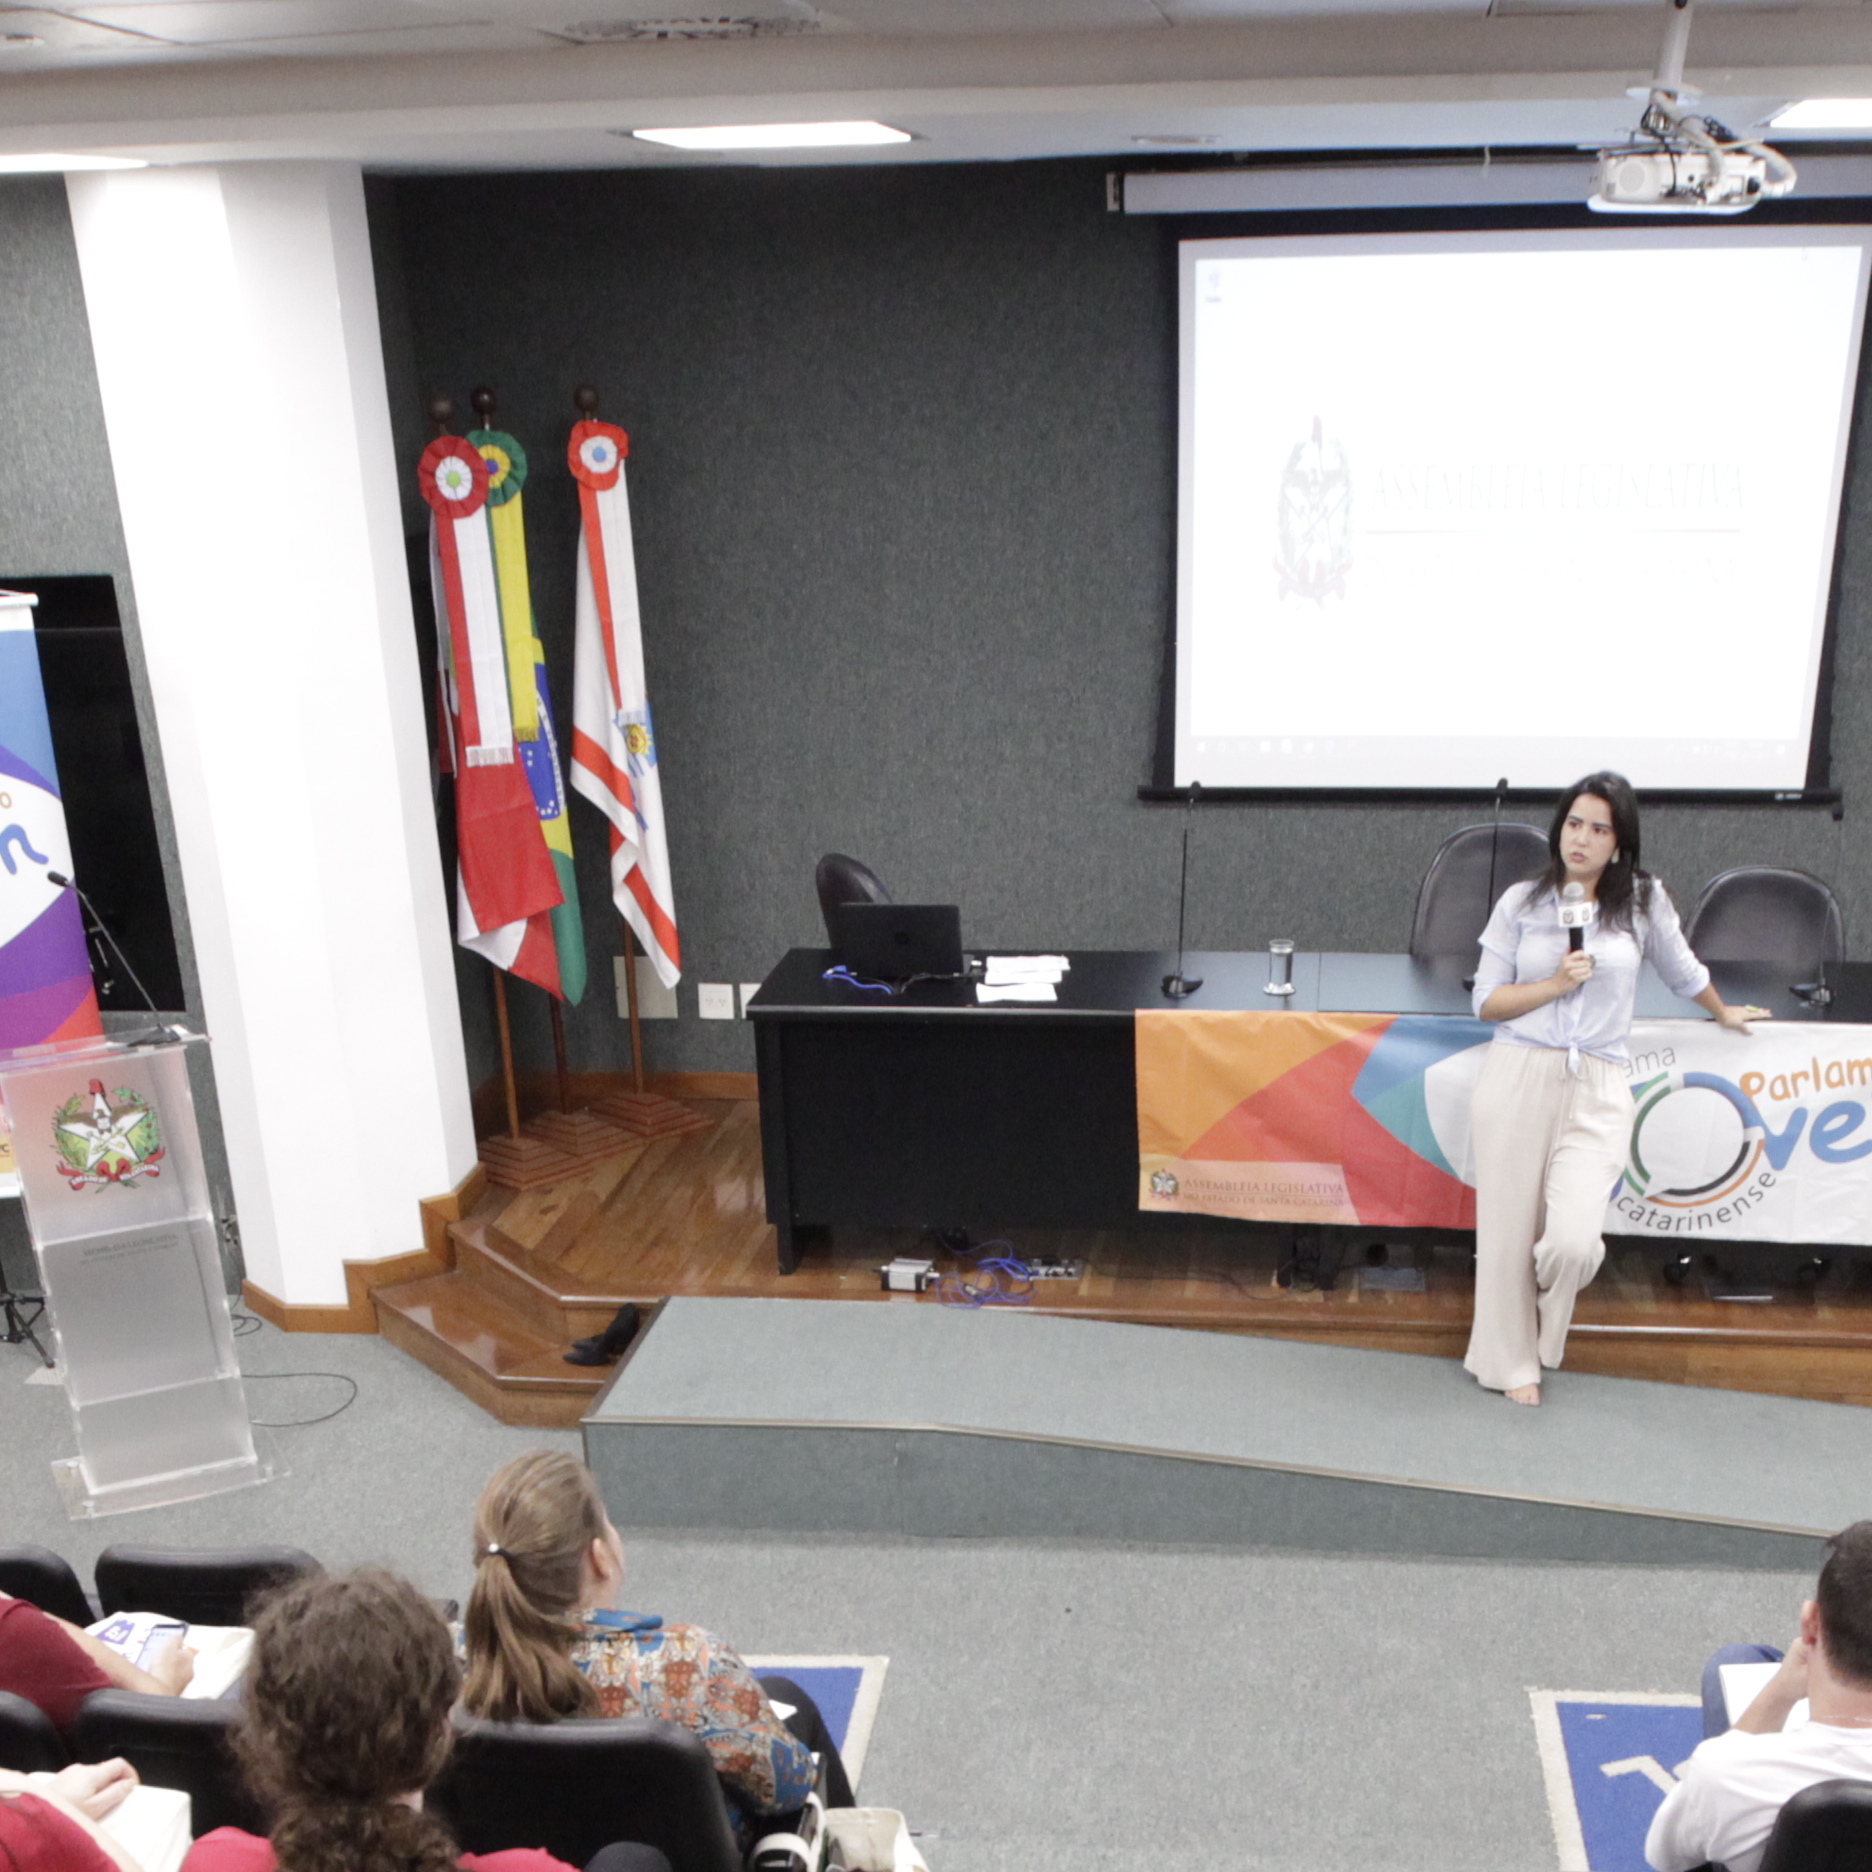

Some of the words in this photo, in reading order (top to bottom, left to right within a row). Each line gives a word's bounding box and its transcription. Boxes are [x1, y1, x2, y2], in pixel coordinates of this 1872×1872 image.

[1183, 1179, 1259, 1192] ASSEMBLEIA
[1264, 1181, 1344, 1194] LEGISLATIVA
[1617, 1171, 1776, 1233] catarinense
